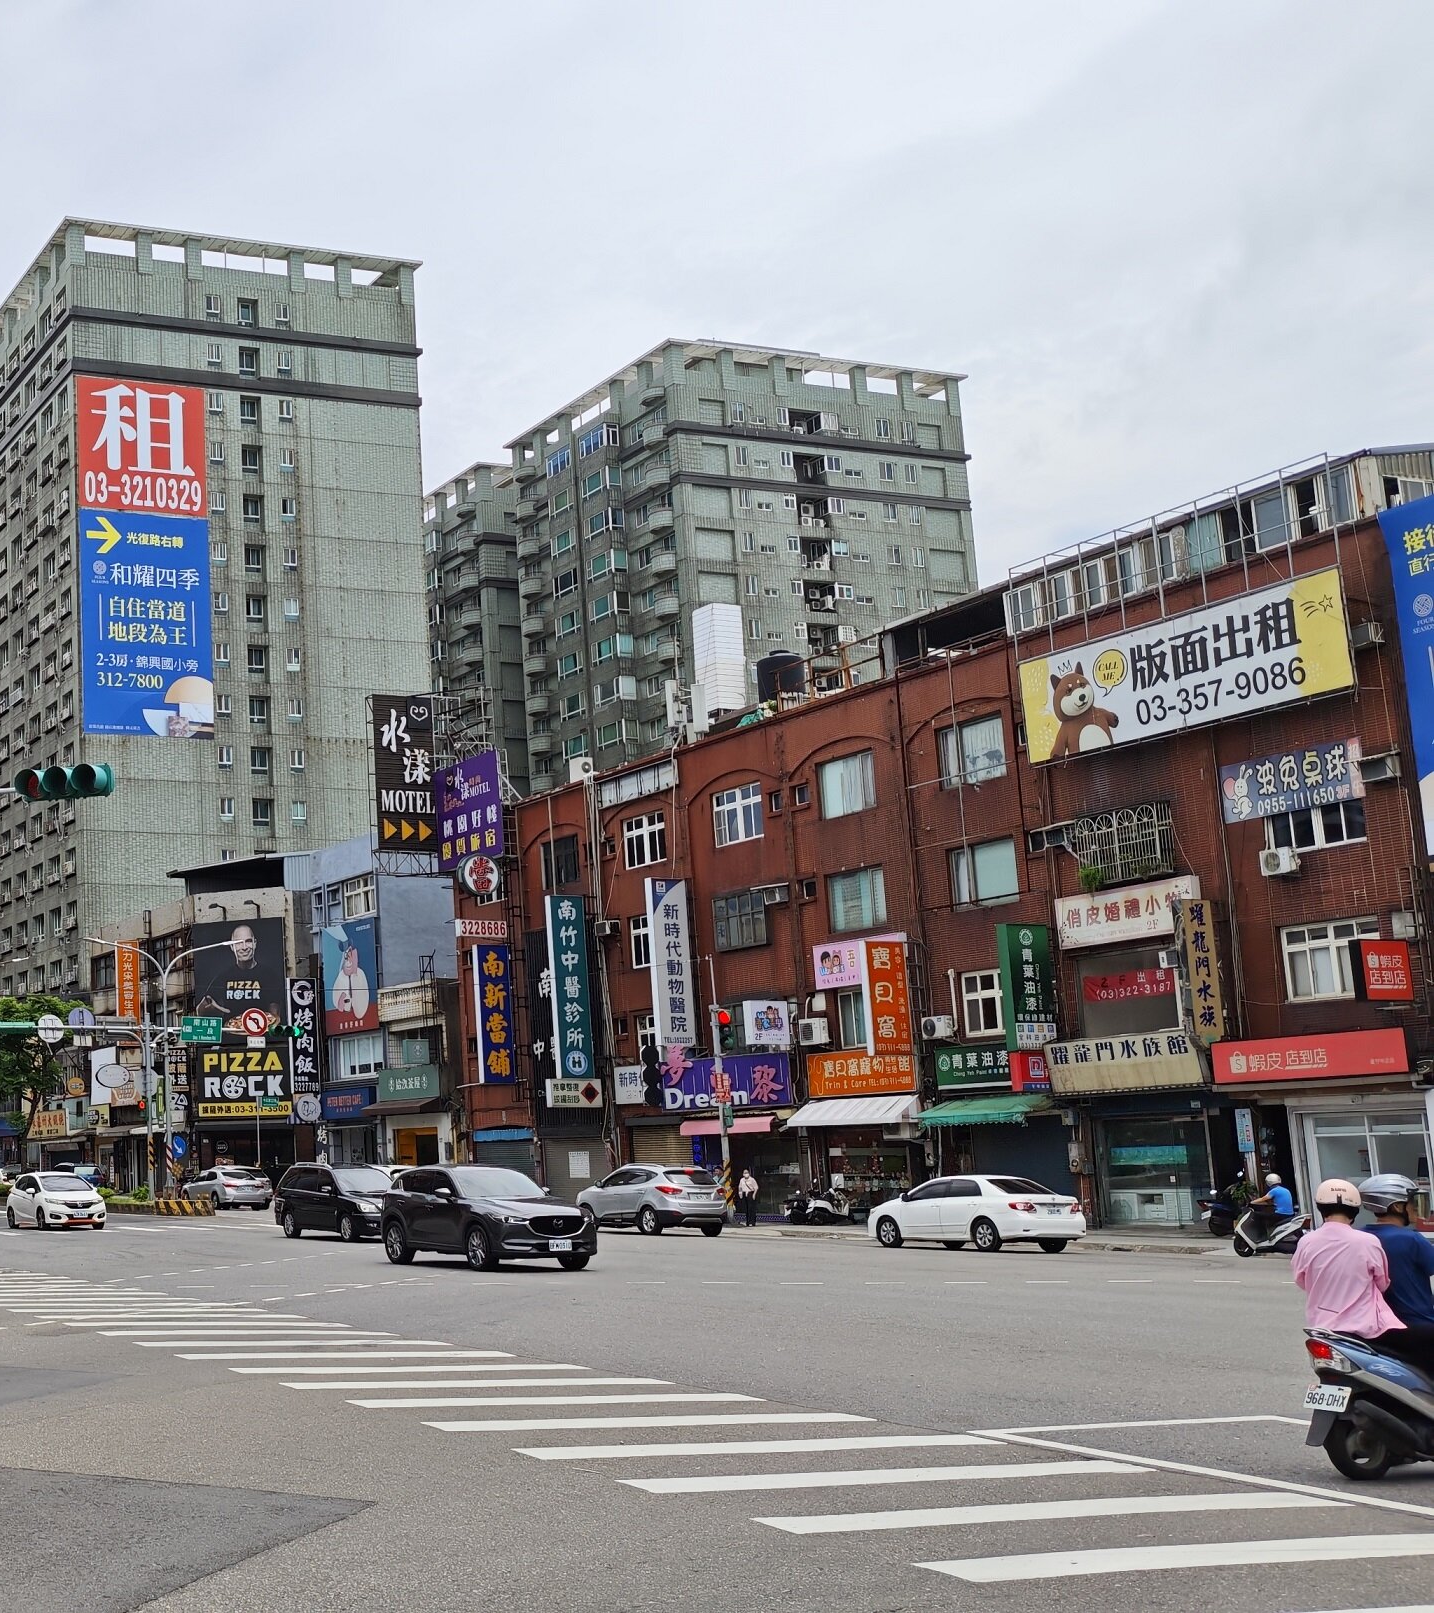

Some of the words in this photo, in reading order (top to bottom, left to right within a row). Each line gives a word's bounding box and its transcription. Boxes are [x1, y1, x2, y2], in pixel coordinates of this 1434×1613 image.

[90, 383, 195, 477] 租
[85, 470, 202, 512] 03-3210329
[126, 532, 184, 549] 光復路右轉
[109, 562, 200, 591] 和耀四季
[109, 596, 186, 622] 自住當道
[107, 621, 188, 646] 地段為王
[1129, 597, 1303, 692] 版面出租
[1097, 660, 1119, 673] CALL
[96, 672, 164, 689] 312-7800
[1135, 655, 1307, 726] 03-357-9086
[380, 789, 435, 814] MOTEL
[469, 781, 491, 798] MOTEL
[1257, 786, 1335, 815] 0955-111650
[461, 920, 506, 937] 3228686
[1146, 919, 1159, 931] 2F
[557, 899, 585, 1050] 南竹中醫診所
[663, 902, 688, 1034] 新時代動物醫院
[1021, 948, 1038, 1011] 青葉油漆
[1369, 968, 1407, 985] 店到店
[226, 981, 261, 990] PIZZA
[226, 989, 261, 1000] ROCK
[1096, 981, 1171, 1001] (03)322-3187
[482, 950, 511, 1078] 南新當舖
[294, 1007, 318, 1075] 烤肉飯
[203, 1050, 284, 1073] PIZZA
[952, 1049, 1009, 1069] 青葉油漆
[1248, 1051, 1284, 1072] 蝦皮
[1285, 1047, 1327, 1065] 店到店
[204, 1074, 284, 1100] ROCK
[1306, 1392, 1347, 1409] 968-DHX
